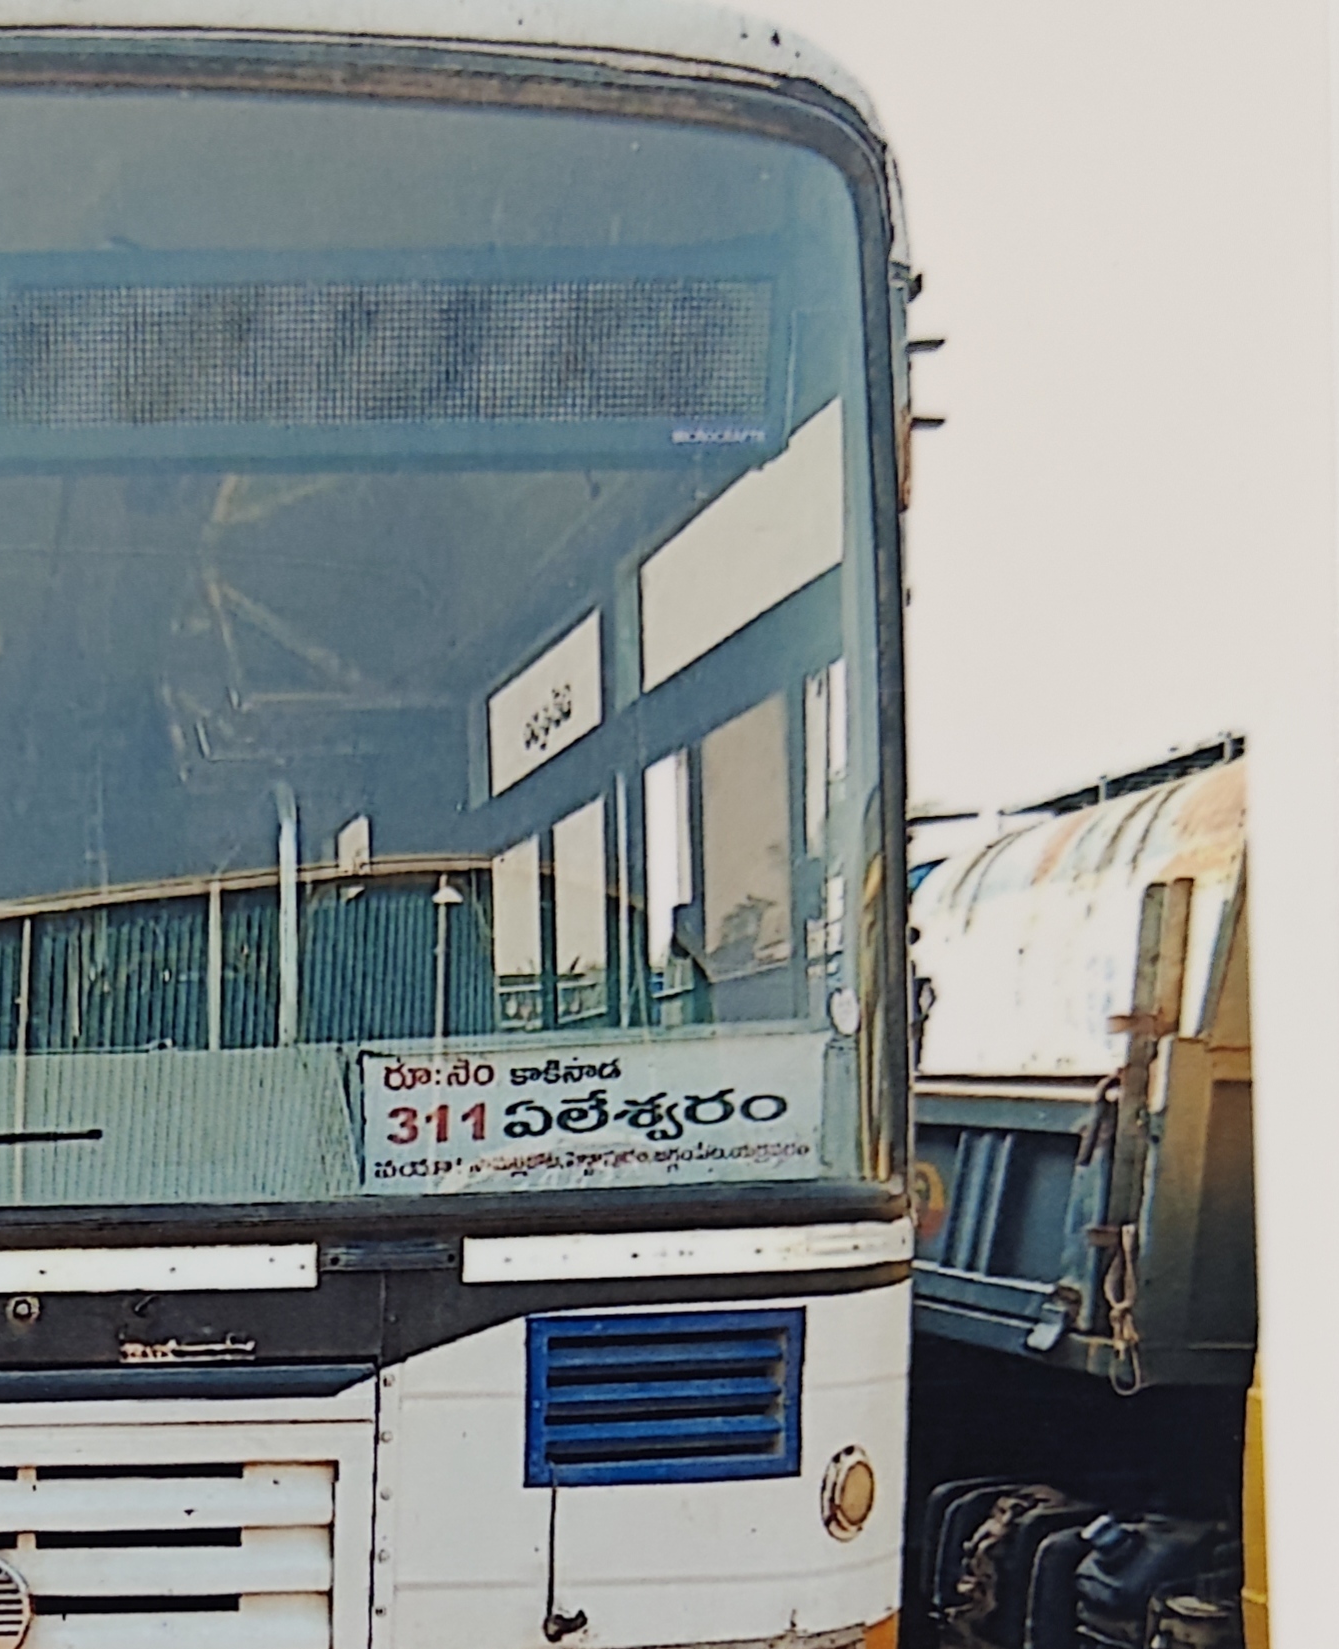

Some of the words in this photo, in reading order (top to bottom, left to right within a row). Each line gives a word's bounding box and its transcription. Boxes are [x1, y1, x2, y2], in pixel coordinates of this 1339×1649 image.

[510, 1056, 622, 1087] కాకినాడ
[386, 1102, 487, 1145] 311
[503, 1087, 789, 1142] ఏలేశ్వరం
